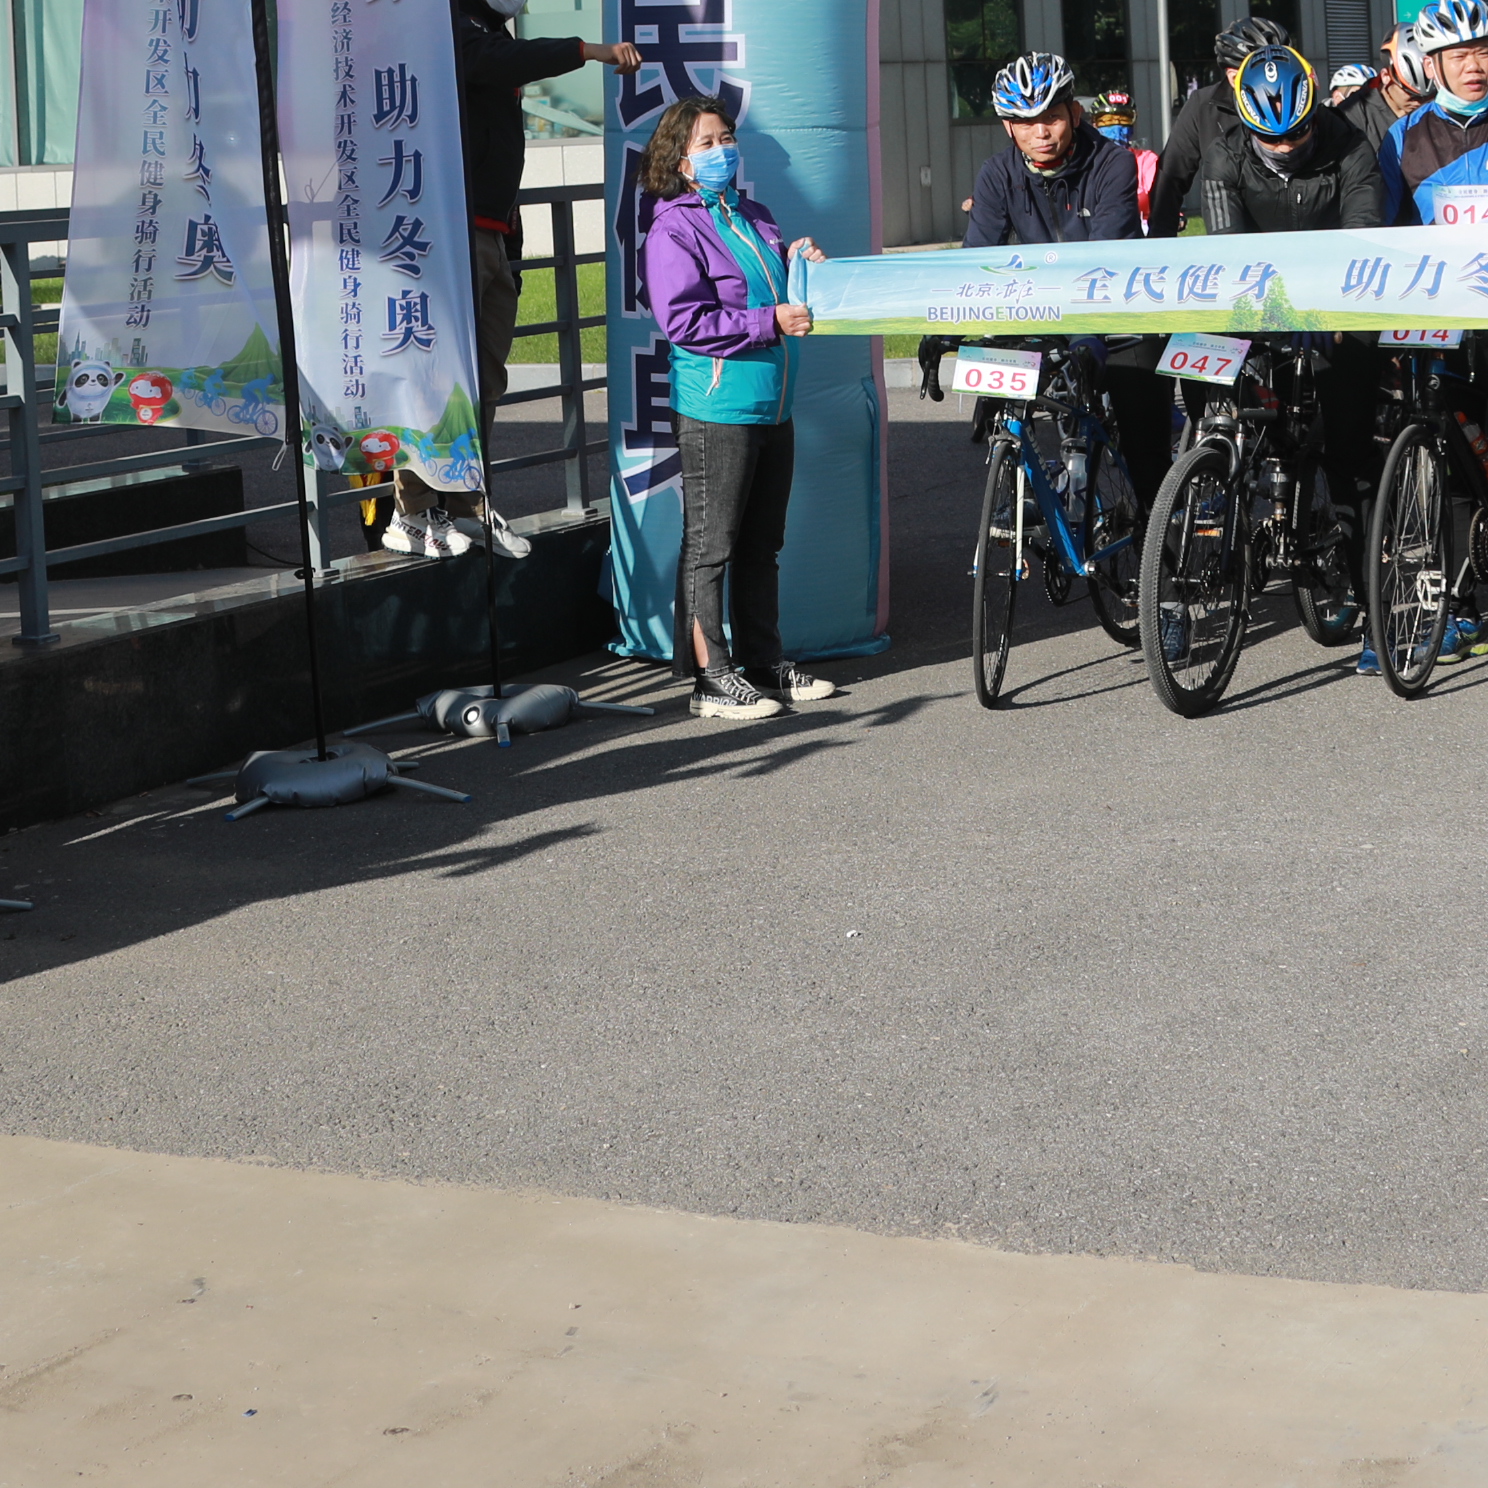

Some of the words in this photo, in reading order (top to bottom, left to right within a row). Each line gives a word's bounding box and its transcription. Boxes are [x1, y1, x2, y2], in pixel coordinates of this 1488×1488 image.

[1109, 95, 1128, 104] 001
[371, 61, 439, 357] 助力冬奥
[1070, 259, 1279, 305] 全民健身
[926, 304, 1061, 324] BEIJINGETOWN
[1169, 351, 1234, 376] 047
[965, 368, 1027, 392] 035
